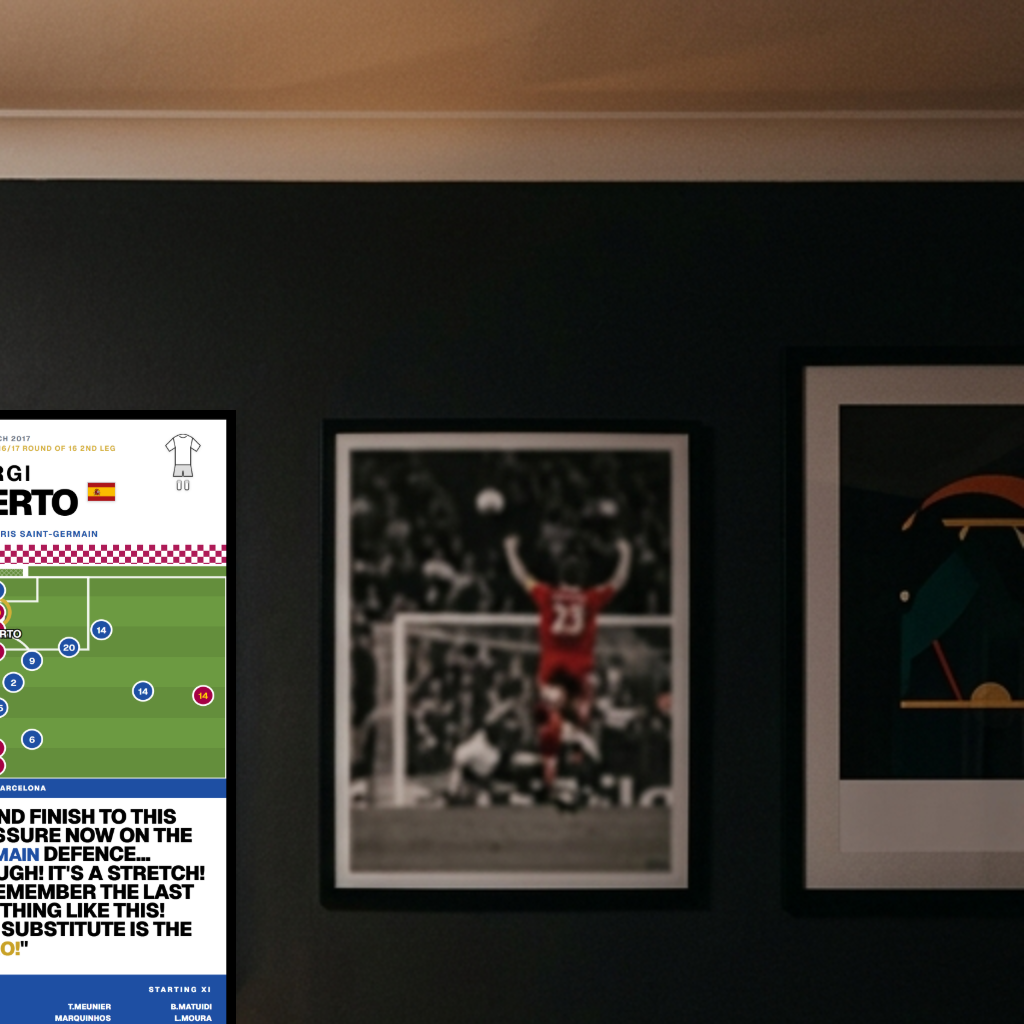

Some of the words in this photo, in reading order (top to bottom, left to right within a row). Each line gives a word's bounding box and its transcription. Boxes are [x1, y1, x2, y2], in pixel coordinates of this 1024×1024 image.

[10, 435, 31, 443] 2017
[22, 444, 53, 452] ROUND
[54, 444, 66, 452] OF
[68, 444, 78, 452] 16
[79, 444, 98, 452] 2ND
[99, 444, 116, 452] LEG
[19, 529, 98, 538] SAINT-GERMAIN
[30, 808, 95, 824] FINISH
[99, 808, 127, 824] TO
[130, 808, 176, 824] THIS
[65, 827, 115, 843] NOW
[119, 827, 149, 843] ON
[153, 828, 192, 843] THE
[44, 846, 151, 862] DEFENCE...
[48, 865, 84, 881] IT'S
[88, 865, 103, 880] A
[108, 865, 205, 881] STRETCH!
[100, 884, 139, 899] THE
[144, 884, 195, 900] LAST
[66, 903, 110, 918] LIKE
[113, 902, 165, 918] THIS!
[1, 921, 125, 937] SUBSTITUTE
[130, 921, 149, 937] IS
[153, 921, 192, 936] THE
[148, 985, 197, 994] STARTING
[200, 985, 211, 993] XI
[67, 1002, 112, 1011] T.MEUNIER
[170, 1002, 213, 1011] B.MATUIDI
[54, 1014, 112, 1023] MARQUINHOS
[174, 1014, 213, 1022] L.MOURA
